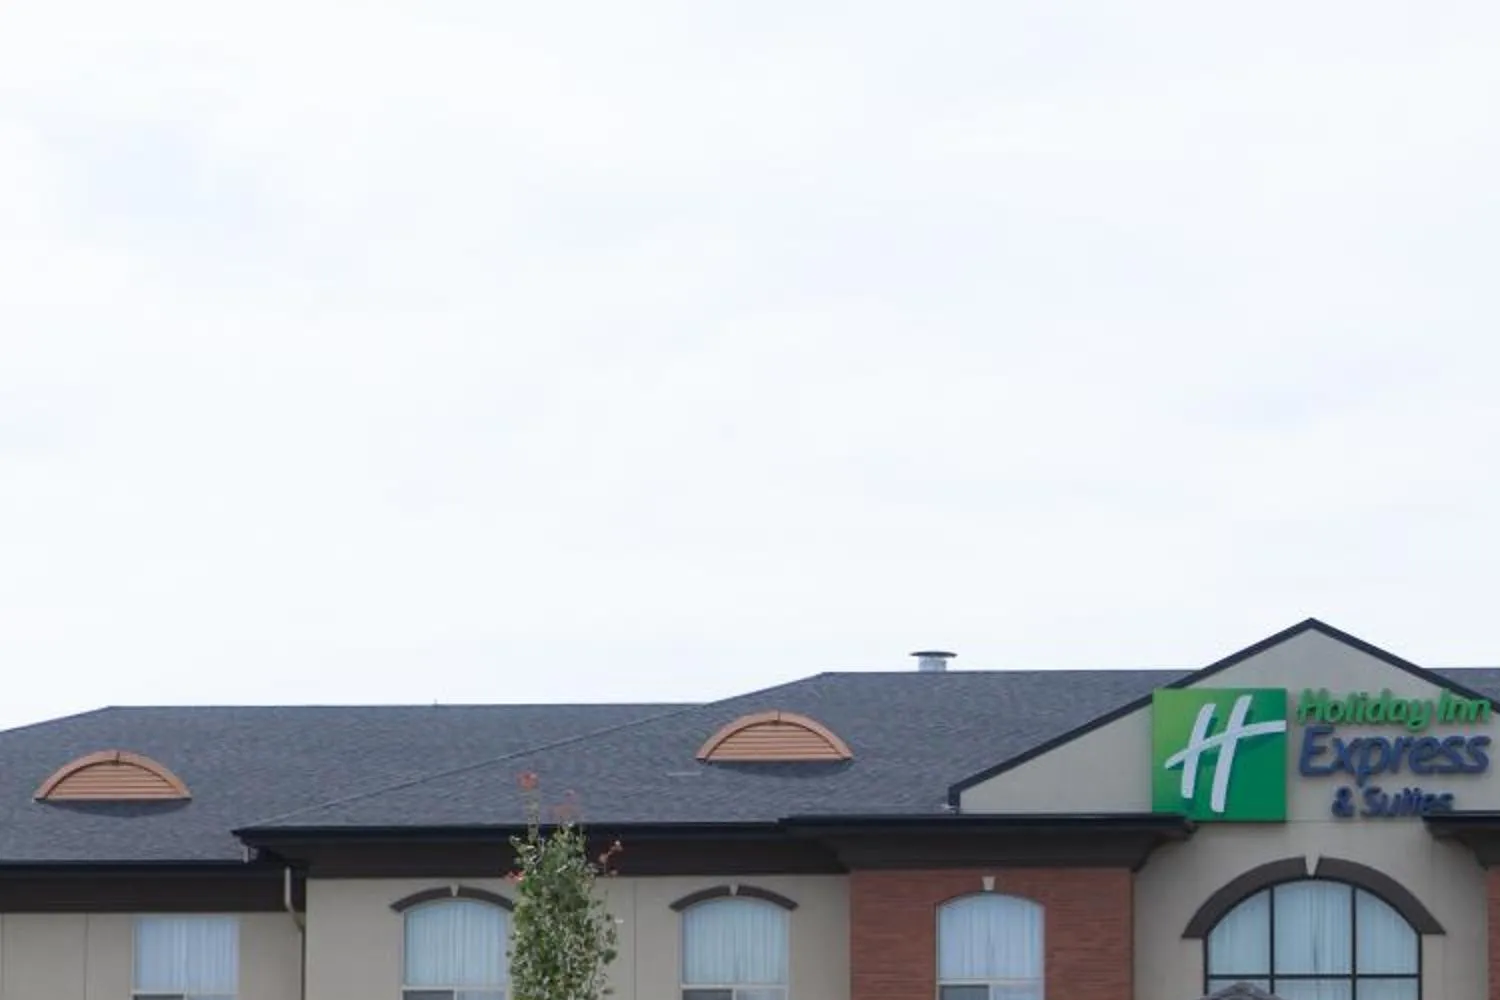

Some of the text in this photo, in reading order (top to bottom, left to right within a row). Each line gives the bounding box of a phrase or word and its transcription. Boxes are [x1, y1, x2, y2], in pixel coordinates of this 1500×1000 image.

[1298, 688, 1491, 732] Holiday Inn
[1299, 724, 1491, 787] Express
[1332, 787, 1454, 817] & Suites
